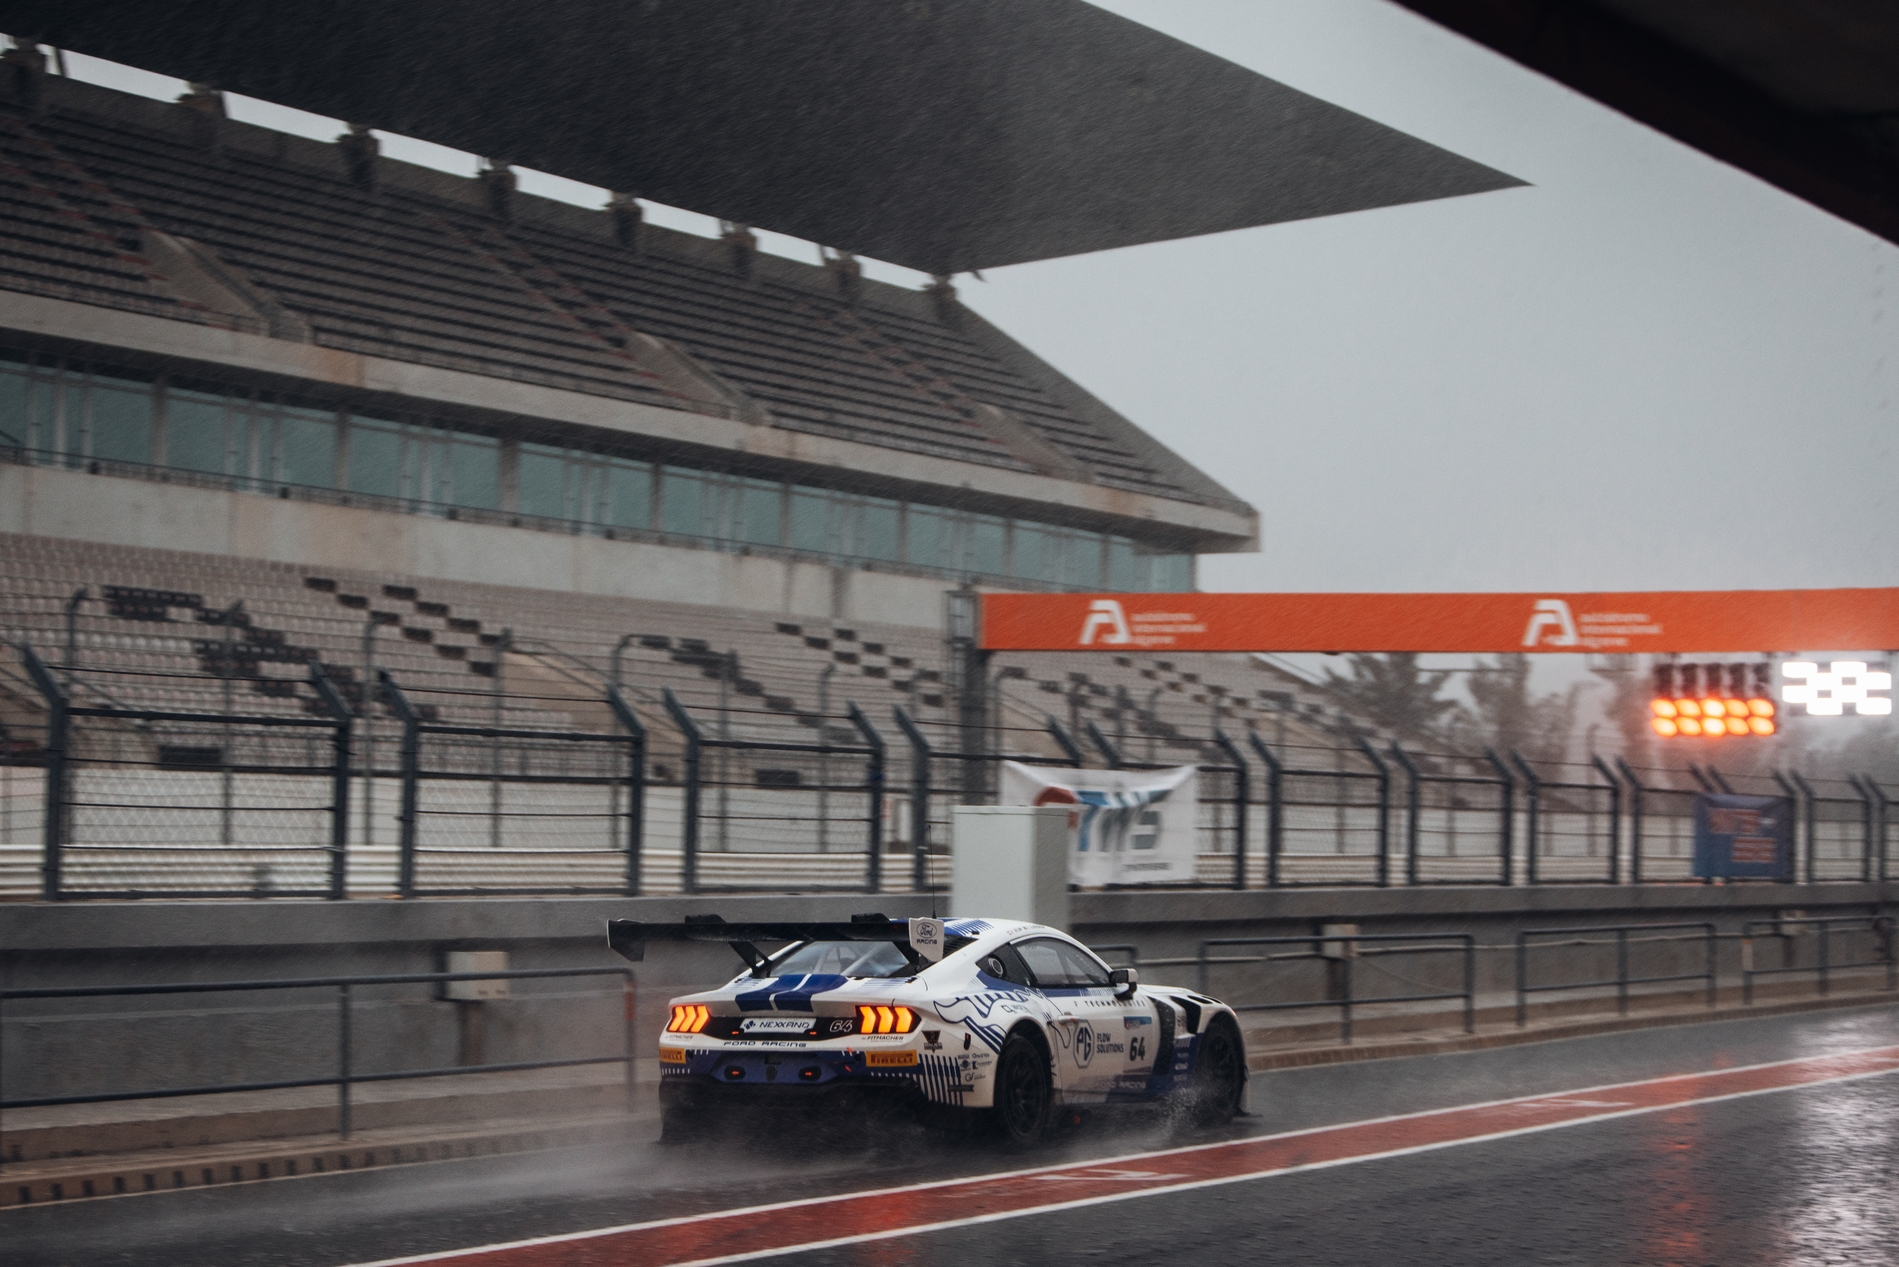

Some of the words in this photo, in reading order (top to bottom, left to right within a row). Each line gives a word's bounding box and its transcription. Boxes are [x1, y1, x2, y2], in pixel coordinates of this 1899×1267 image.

[829, 1019, 854, 1033] 64
[1096, 1032, 1112, 1043] FLOW
[1096, 1043, 1125, 1054] SOLUTIONS
[1129, 1036, 1146, 1062] 64
[870, 1053, 913, 1064] PIRELLI
